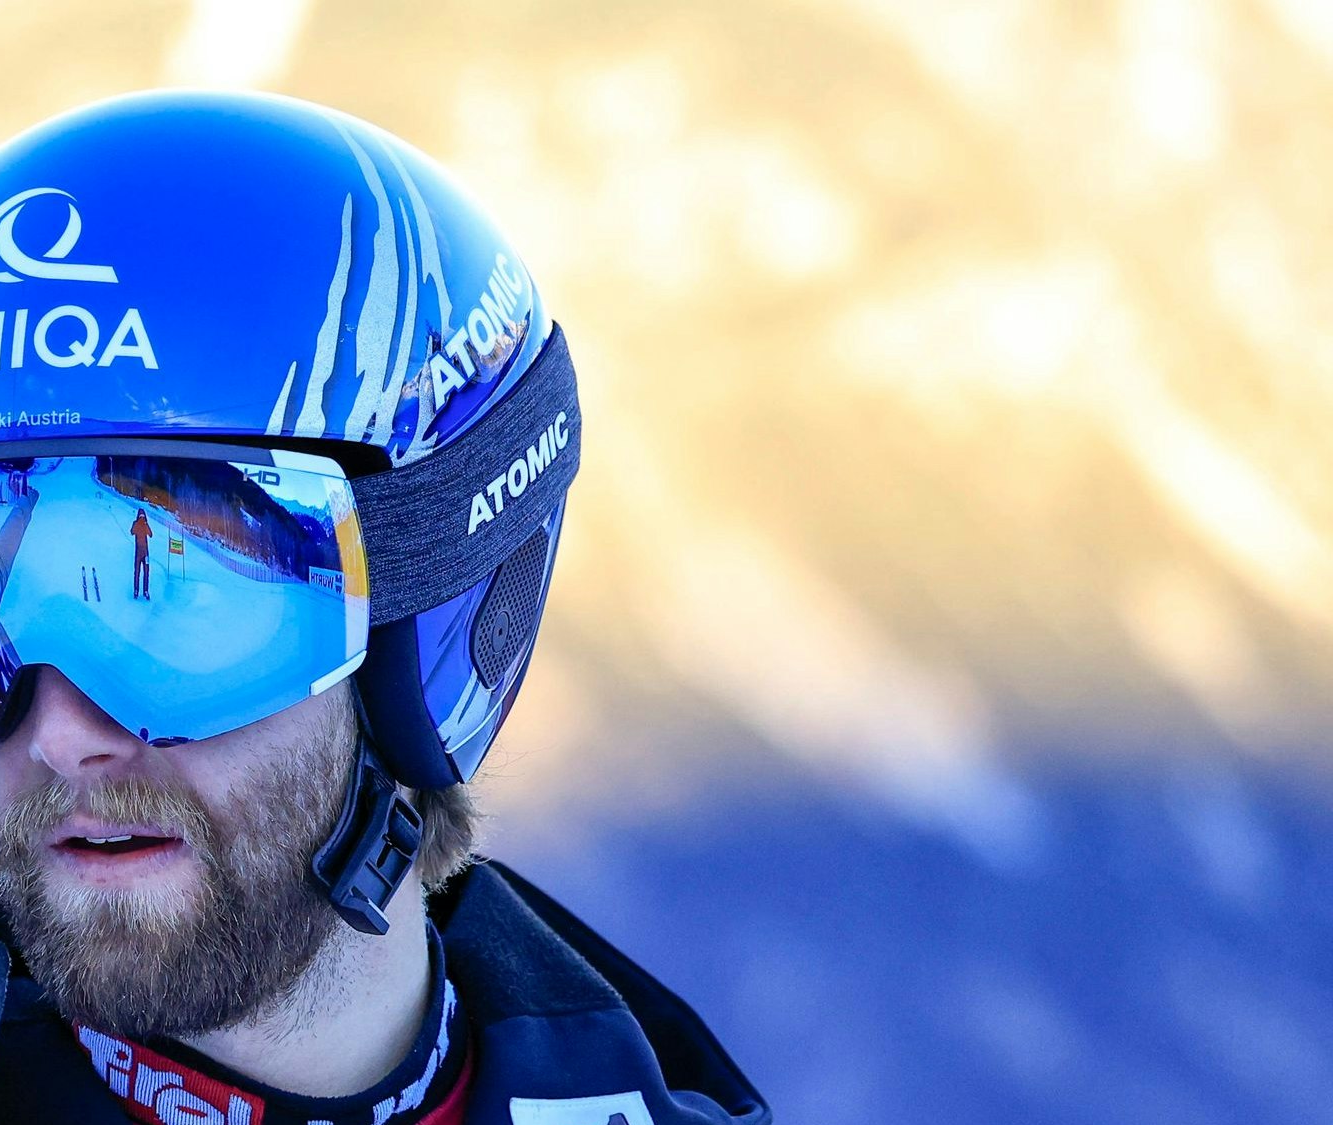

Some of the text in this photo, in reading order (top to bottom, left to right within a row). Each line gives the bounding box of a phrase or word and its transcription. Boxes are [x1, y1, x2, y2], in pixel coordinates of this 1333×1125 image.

[430, 253, 523, 410] ATOMIC
[16, 409, 81, 427] Austria
[467, 411, 570, 536] ATOMIC
